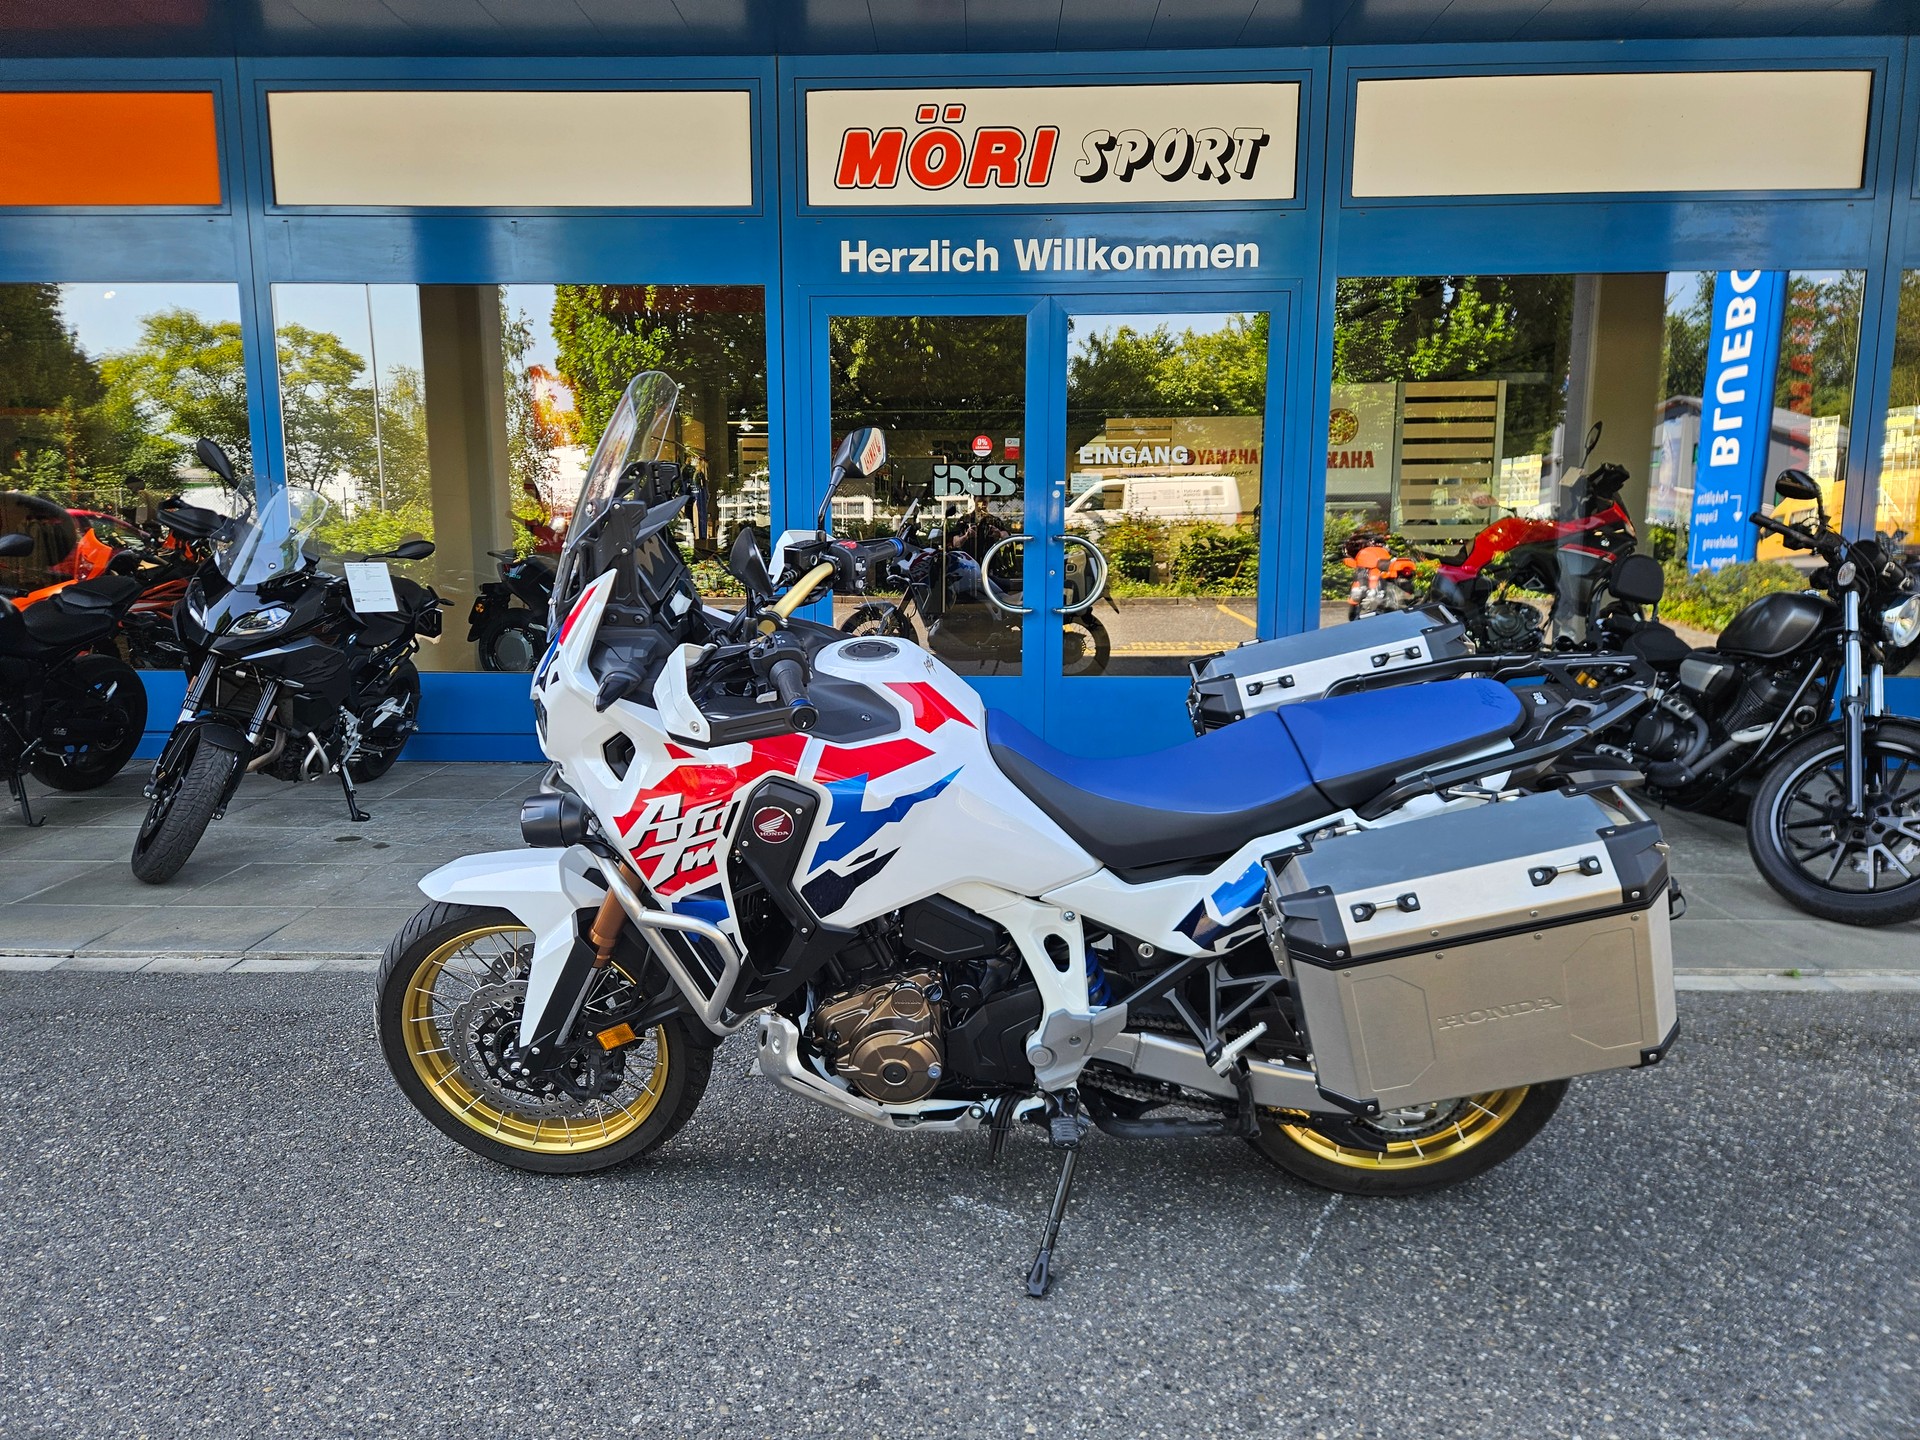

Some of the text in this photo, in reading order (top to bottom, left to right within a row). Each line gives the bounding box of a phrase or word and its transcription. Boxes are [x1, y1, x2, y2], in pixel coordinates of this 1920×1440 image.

[833, 103, 1269, 191] MÖRI SPORT
[840, 237, 1259, 273] Herzlich Willkommen
[976, 438, 988, 446] 0%
[1079, 446, 1189, 465] EINGANG
[1198, 448, 1259, 465] YAMAHA
[1438, 996, 1563, 1030] HONDA
